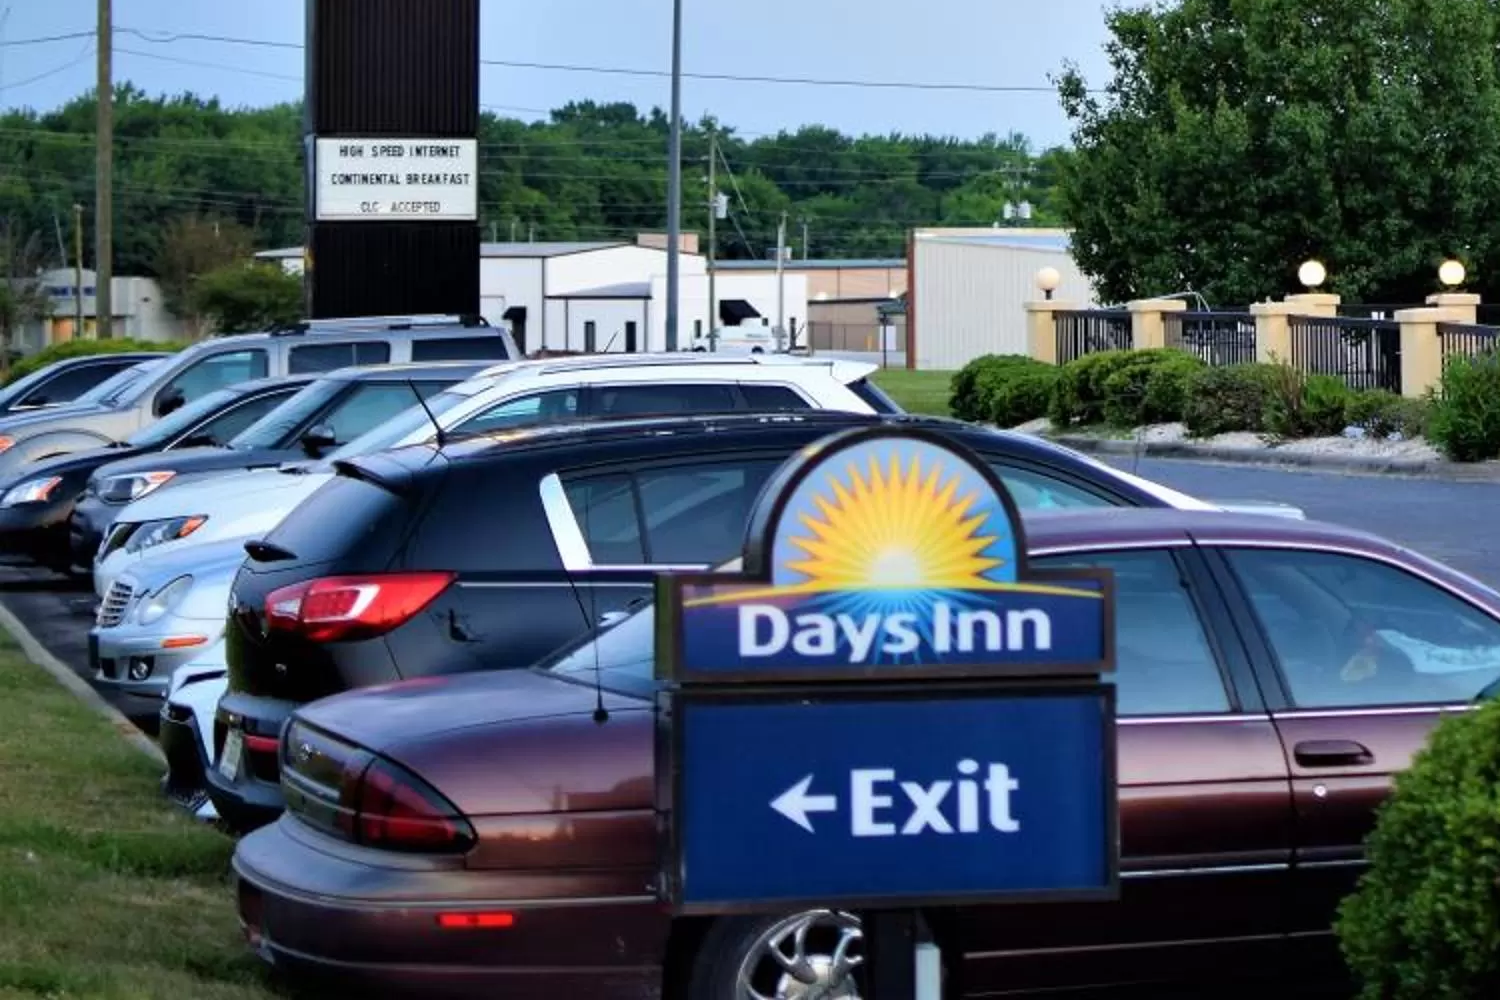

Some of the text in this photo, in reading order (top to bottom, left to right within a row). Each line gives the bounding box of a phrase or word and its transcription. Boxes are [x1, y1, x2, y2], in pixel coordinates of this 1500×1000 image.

[339, 145, 461, 157] HIGH SPEED INTERNET
[331, 173, 470, 185] CONTINENTAL BREAKFAST
[360, 201, 441, 213] CLC ACCEPTED
[738, 601, 1052, 662] Days Inn
[850, 758, 1020, 836] Exit
